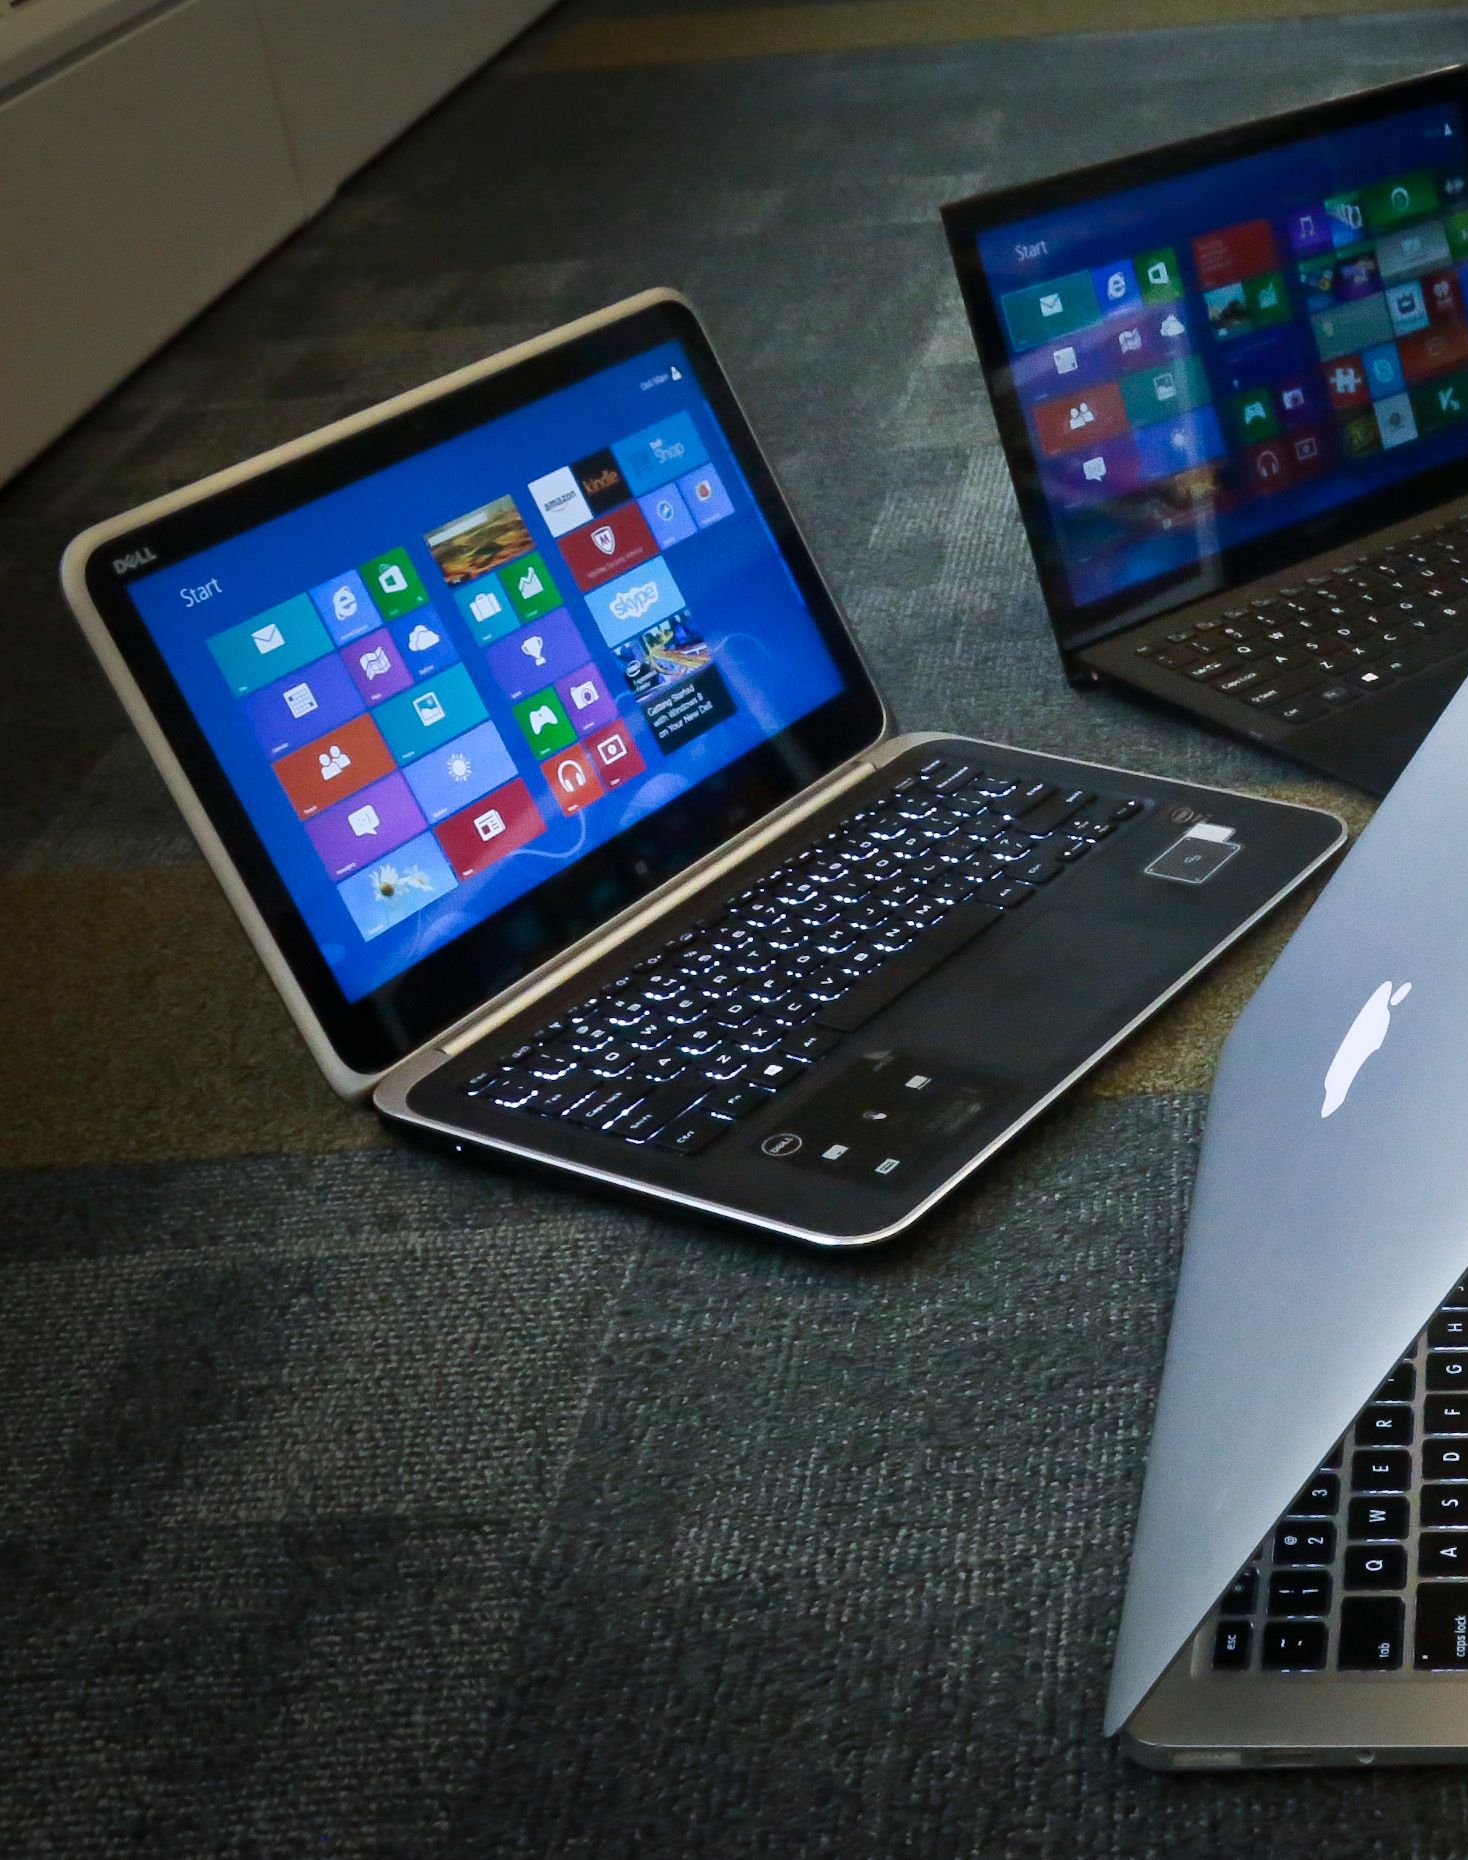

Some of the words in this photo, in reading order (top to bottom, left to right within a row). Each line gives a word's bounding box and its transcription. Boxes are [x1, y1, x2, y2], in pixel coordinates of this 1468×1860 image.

[1014, 240, 1048, 261] Start
[582, 468, 621, 495] kindle
[545, 490, 577, 512] amazon
[112, 547, 157, 575] DELL
[179, 577, 223, 608] Start
[614, 585, 657, 613] skype
[647, 693, 672, 716] Getting
[671, 684, 695, 703] Started
[658, 727, 670, 739] on
[667, 717, 684, 733] Your
[683, 709, 701, 726] New
[1448, 1323, 1462, 1331] H
[1446, 1365, 1462, 1374] G
[1443, 1452, 1460, 1461] D
[1442, 1499, 1458, 1507] S
[1369, 1510, 1386, 1522] W
[1284, 1536, 1297, 1545] @
[1440, 1547, 1457, 1557] A
[1366, 1560, 1383, 1571] Q
[1456, 1614, 1467, 1635] lock
[1227, 1634, 1237, 1651] esc
[1378, 1642, 1391, 1658] tab
[1456, 1637, 1466, 1659] caps
